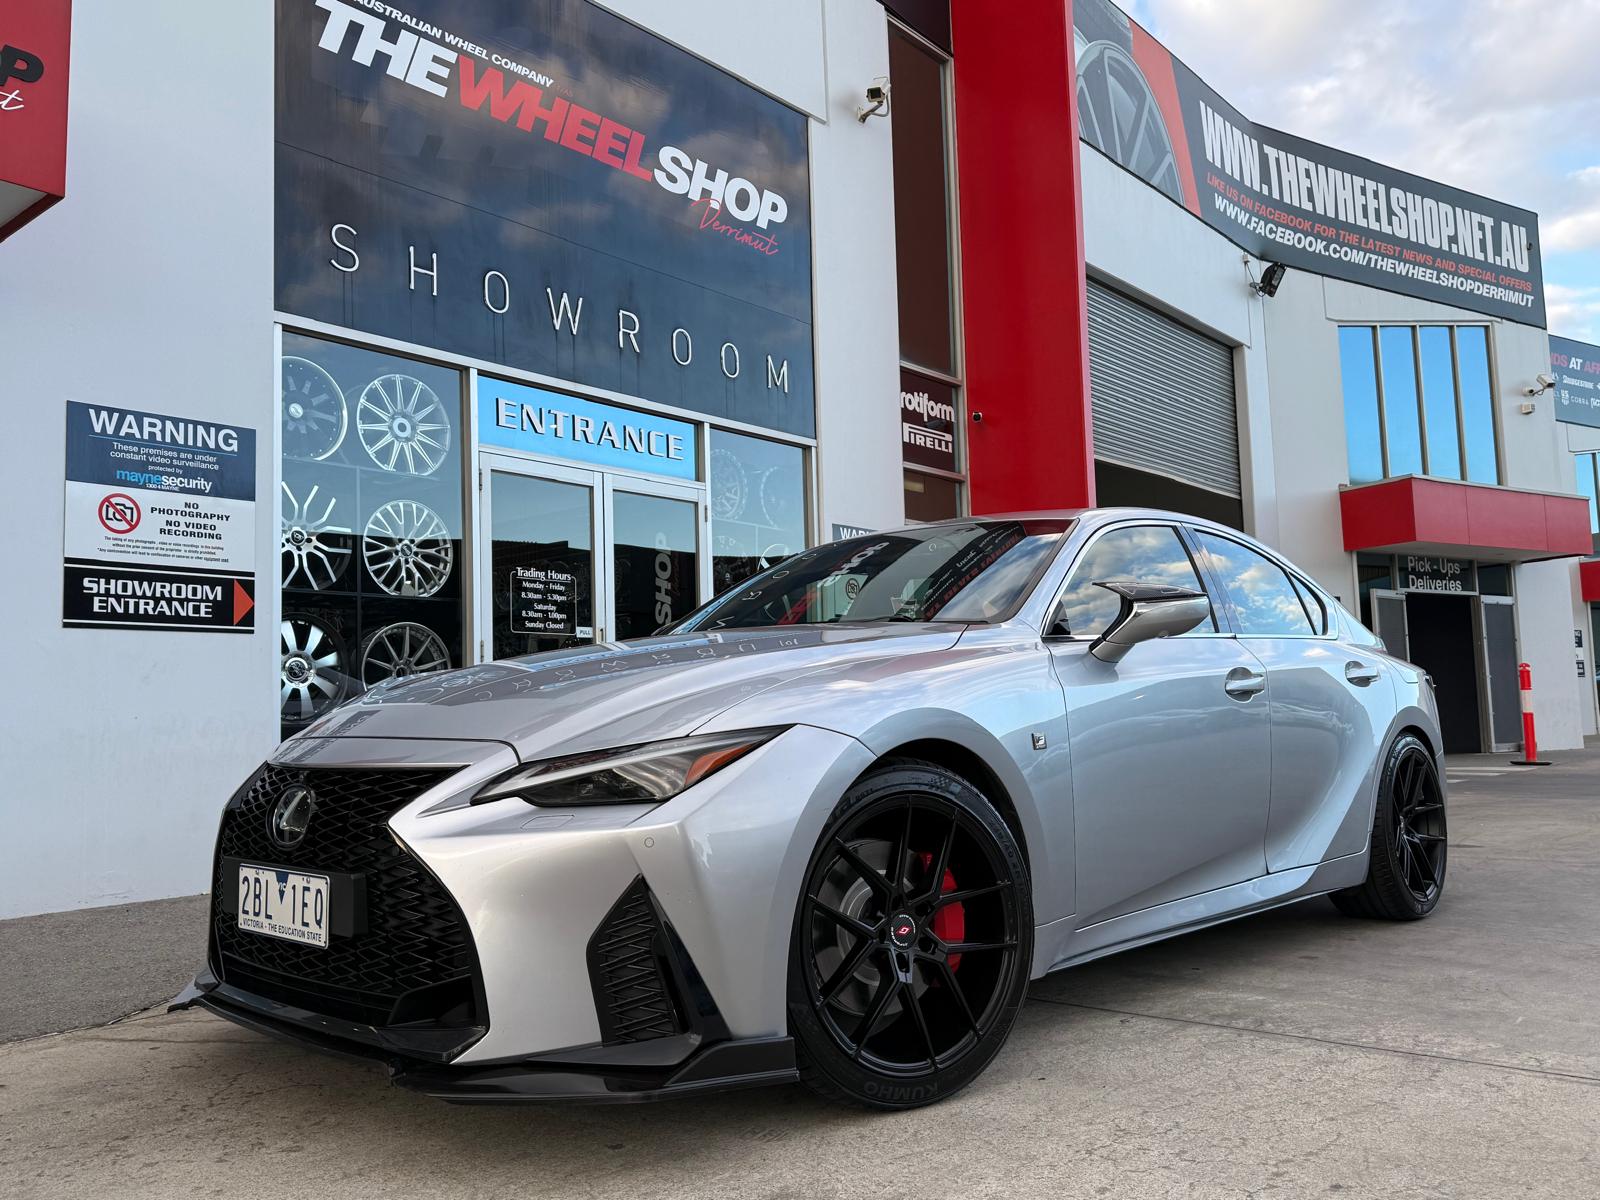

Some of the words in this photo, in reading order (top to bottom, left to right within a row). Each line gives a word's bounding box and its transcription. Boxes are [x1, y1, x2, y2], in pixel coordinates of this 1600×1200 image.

[444, 32, 488, 60] WHEEL
[492, 54, 554, 87] COMPANY
[1200, 100, 1530, 273] WWW.THEWHEELSHOP.NET.AU
[690, 198, 779, 255] Derrimut
[1208, 172, 1225, 192] LIKE
[1226, 185, 1239, 202] US
[1240, 194, 1253, 210] ON
[1254, 202, 1313, 232] FACEBOOK
[1314, 224, 1336, 238] FOR
[1339, 230, 1360, 246] THE
[1361, 236, 1401, 256] LATEST
[1402, 249, 1432, 265] NEWS
[1434, 258, 1456, 271] AND
[1458, 264, 1497, 282] SPECIAL
[1499, 275, 1532, 292] OFFERS
[1214, 192, 1534, 308] WWW.FACEBOOK.COM/THEWHEELSHOPDERRIMUT
[330, 224, 788, 394] SHOWROOM
[1569, 357, 1582, 370] AT
[901, 392, 955, 422] rotiform
[88, 408, 238, 452] WARNING
[496, 397, 684, 460] ENTRANCE
[903, 422, 952, 454] PIRELLI
[110, 450, 147, 462] constant
[148, 455, 170, 464] video
[172, 459, 219, 470] surveillance
[112, 442, 138, 452] These
[140, 446, 178, 458] premises
[180, 452, 192, 460] are
[194, 454, 216, 462] under
[148, 464, 174, 473] protected
[150, 506, 230, 521] PHOTOGRAPHY
[160, 528, 222, 540] RECORDING
[184, 522, 216, 531] VIDEO
[516, 566, 546, 581] Trading
[548, 570, 571, 581] Hours
[1408, 556, 1431, 572] Pick
[1440, 558, 1460, 577] Ups
[82, 577, 222, 601] SHOWROOM
[522, 581, 544, 591] Monday
[550, 583, 565, 592] Friday
[1409, 575, 1462, 591] Deliveries
[92, 596, 213, 618] ENTRANCE
[534, 603, 556, 612] Saturday
[525, 621, 545, 629] Sunday
[242, 876, 272, 920] 2BL
[292, 884, 323, 929] 1EQ
[242, 917, 264, 929] VICTORIA
[268, 923, 277, 933] THE
[278, 924, 305, 939] EDUCATION
[307, 931, 321, 942] STATE
